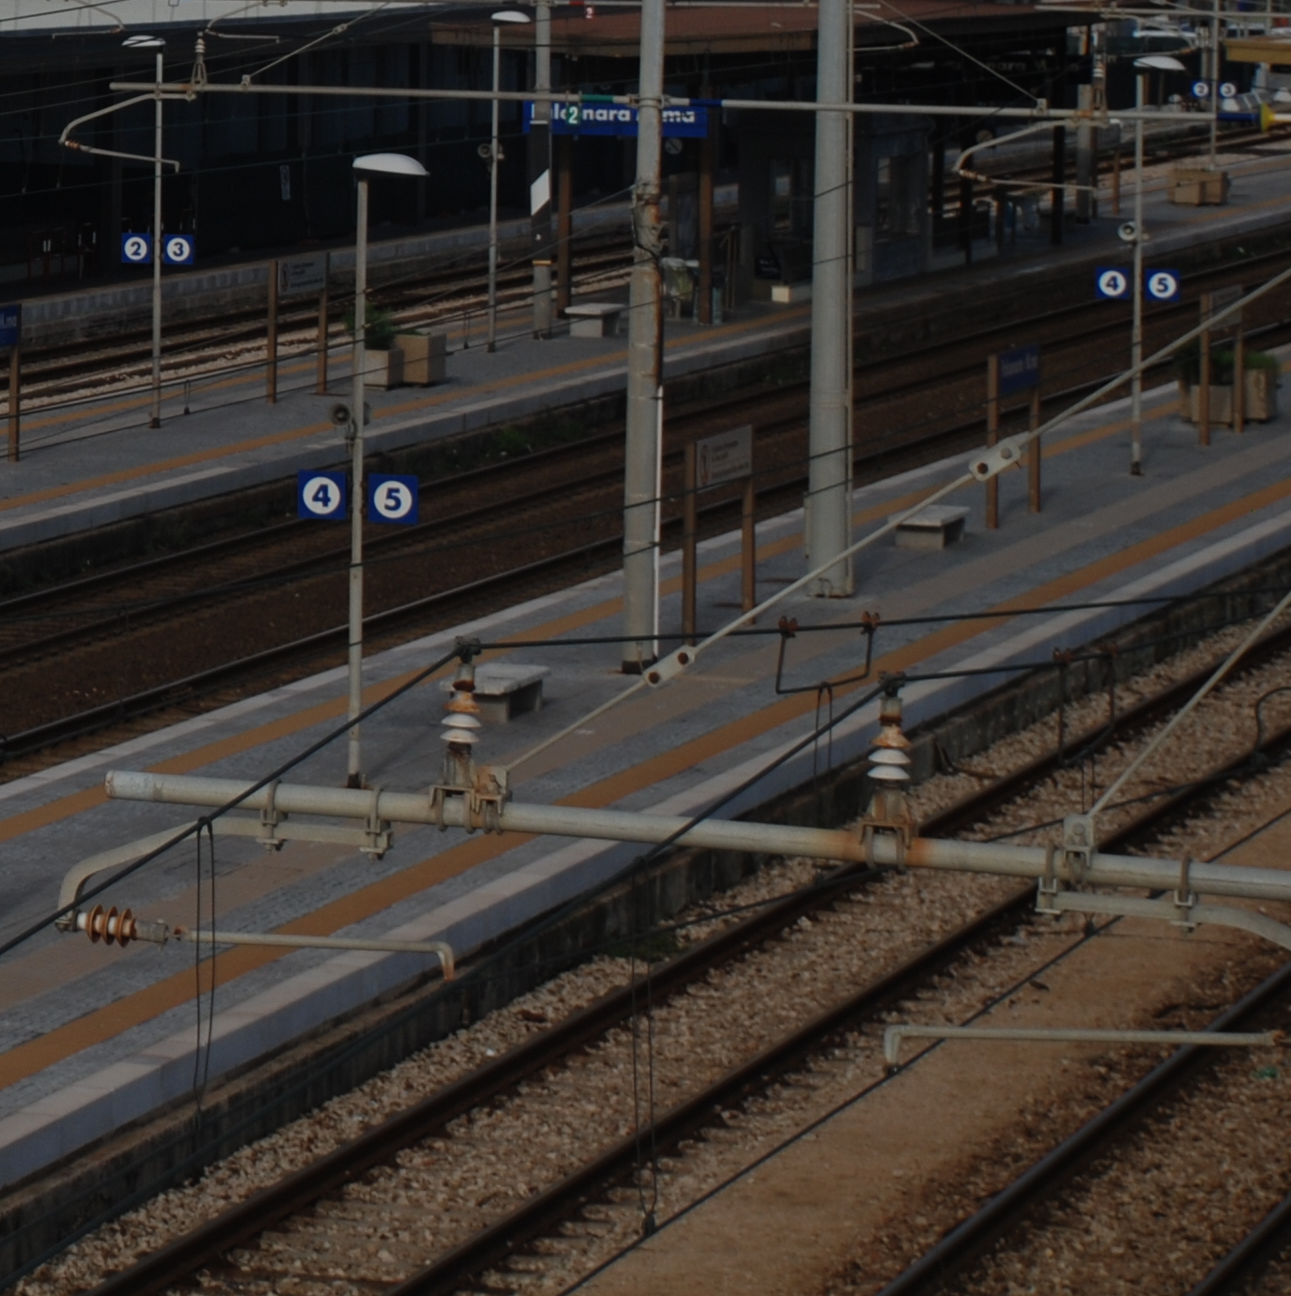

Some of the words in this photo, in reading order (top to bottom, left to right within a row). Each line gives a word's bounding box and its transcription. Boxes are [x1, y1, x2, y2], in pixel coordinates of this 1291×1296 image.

[568, 106, 578, 124] 2
[130, 241, 141, 256] 2
[172, 242, 183, 257] 3
[1106, 275, 1119, 292] 4
[1156, 277, 1169, 293] 5
[312, 484, 331, 507] 4
[384, 487, 402, 511] 5
